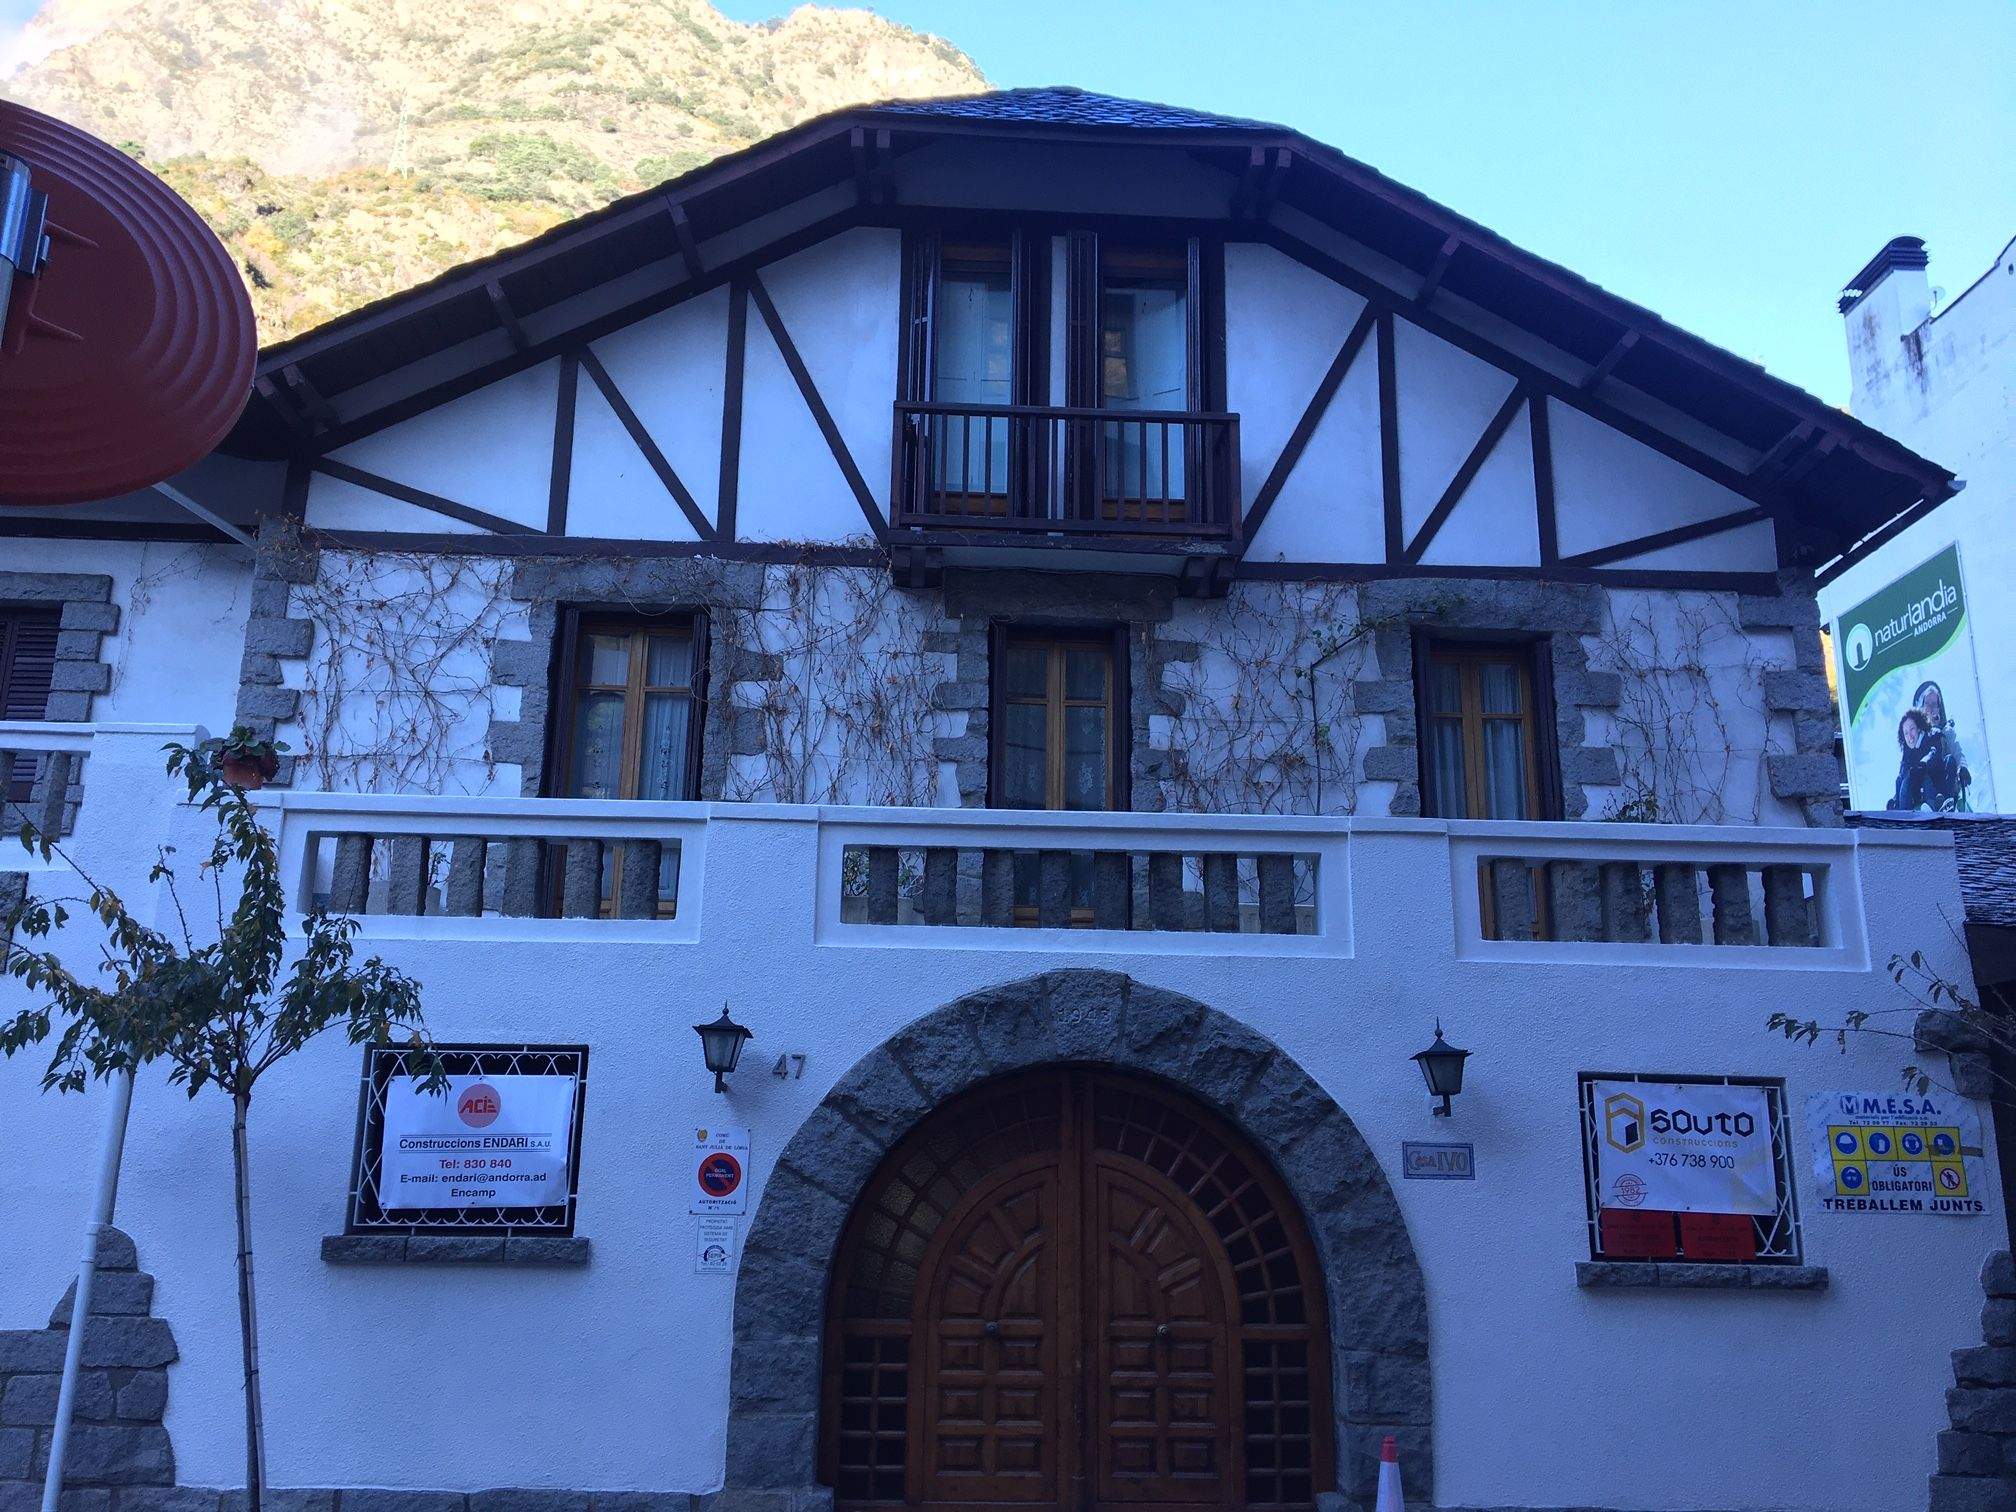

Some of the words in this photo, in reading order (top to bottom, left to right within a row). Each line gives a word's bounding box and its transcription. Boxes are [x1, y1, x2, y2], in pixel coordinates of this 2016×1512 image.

[1875, 578, 1957, 647] naturlandia
[1913, 611, 1947, 637] ANDORRA
[771, 1053, 806, 1079] 47
[1863, 1098, 1942, 1115] M.E.S.A.
[399, 1138, 480, 1149] Construccions
[483, 1138, 528, 1148] ENDARI
[530, 1140, 552, 1148] S.A.U.
[439, 1160, 460, 1169] Tel:
[463, 1159, 486, 1169] 830
[489, 1159, 512, 1168] 840
[1648, 1152, 1678, 1167] +376
[1681, 1154, 1706, 1168] 738
[1709, 1155, 1735, 1169] 900
[1893, 1164, 1907, 1177] ÚS
[400, 1174, 438, 1183] E-mail:
[441, 1173, 547, 1183] endari@andorra.ad
[1872, 1180, 1933, 1192] OBLIGATORI
[451, 1188, 496, 1199] Encamp
[1823, 1198, 1923, 1212] TREBALLEM
